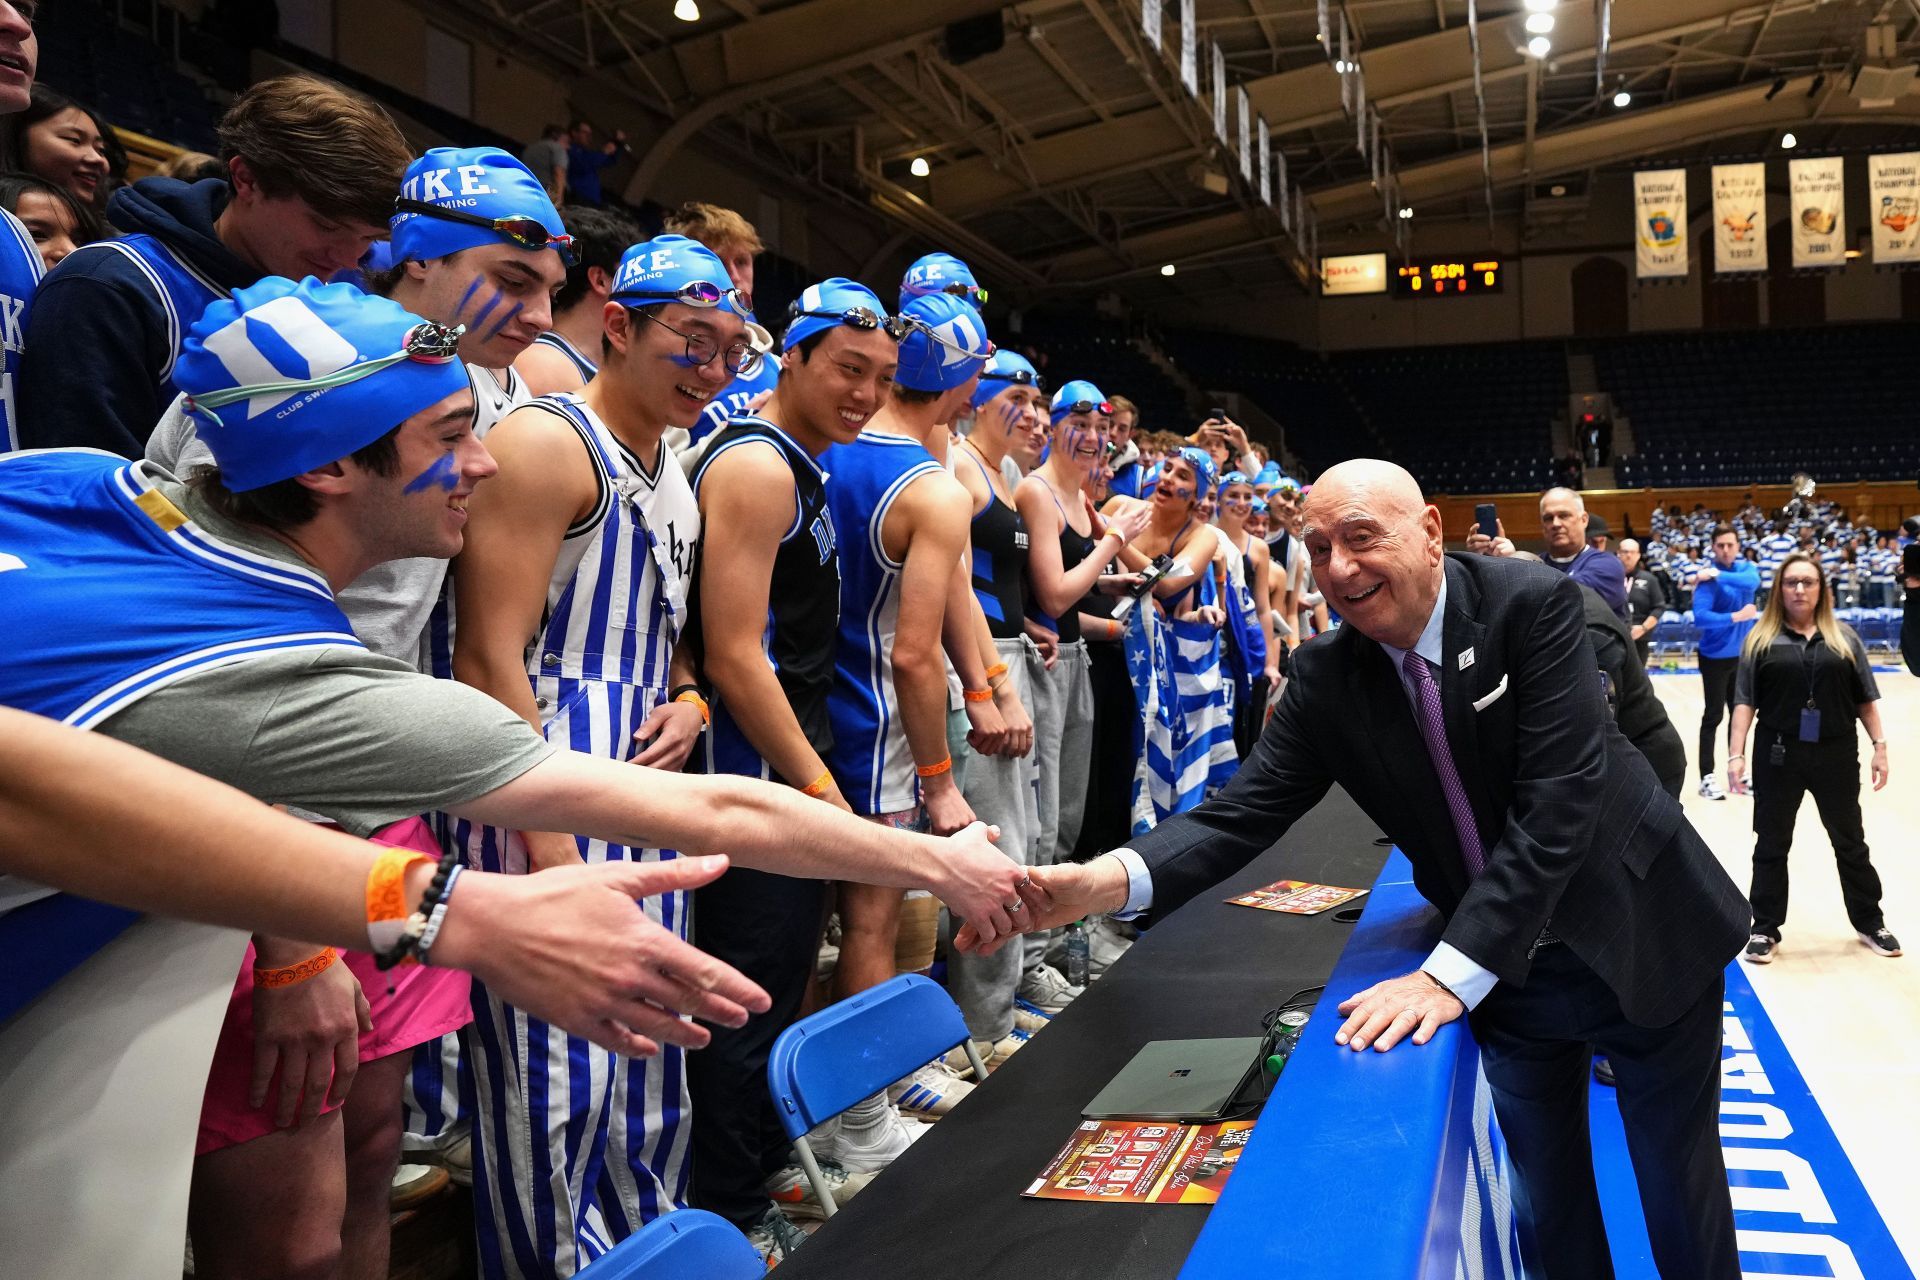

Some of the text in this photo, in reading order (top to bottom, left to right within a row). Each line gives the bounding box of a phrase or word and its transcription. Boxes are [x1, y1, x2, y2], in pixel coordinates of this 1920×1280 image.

[397, 164, 491, 204] UKE
[611, 248, 674, 293] UKE
[276, 400, 304, 420] CLUB
